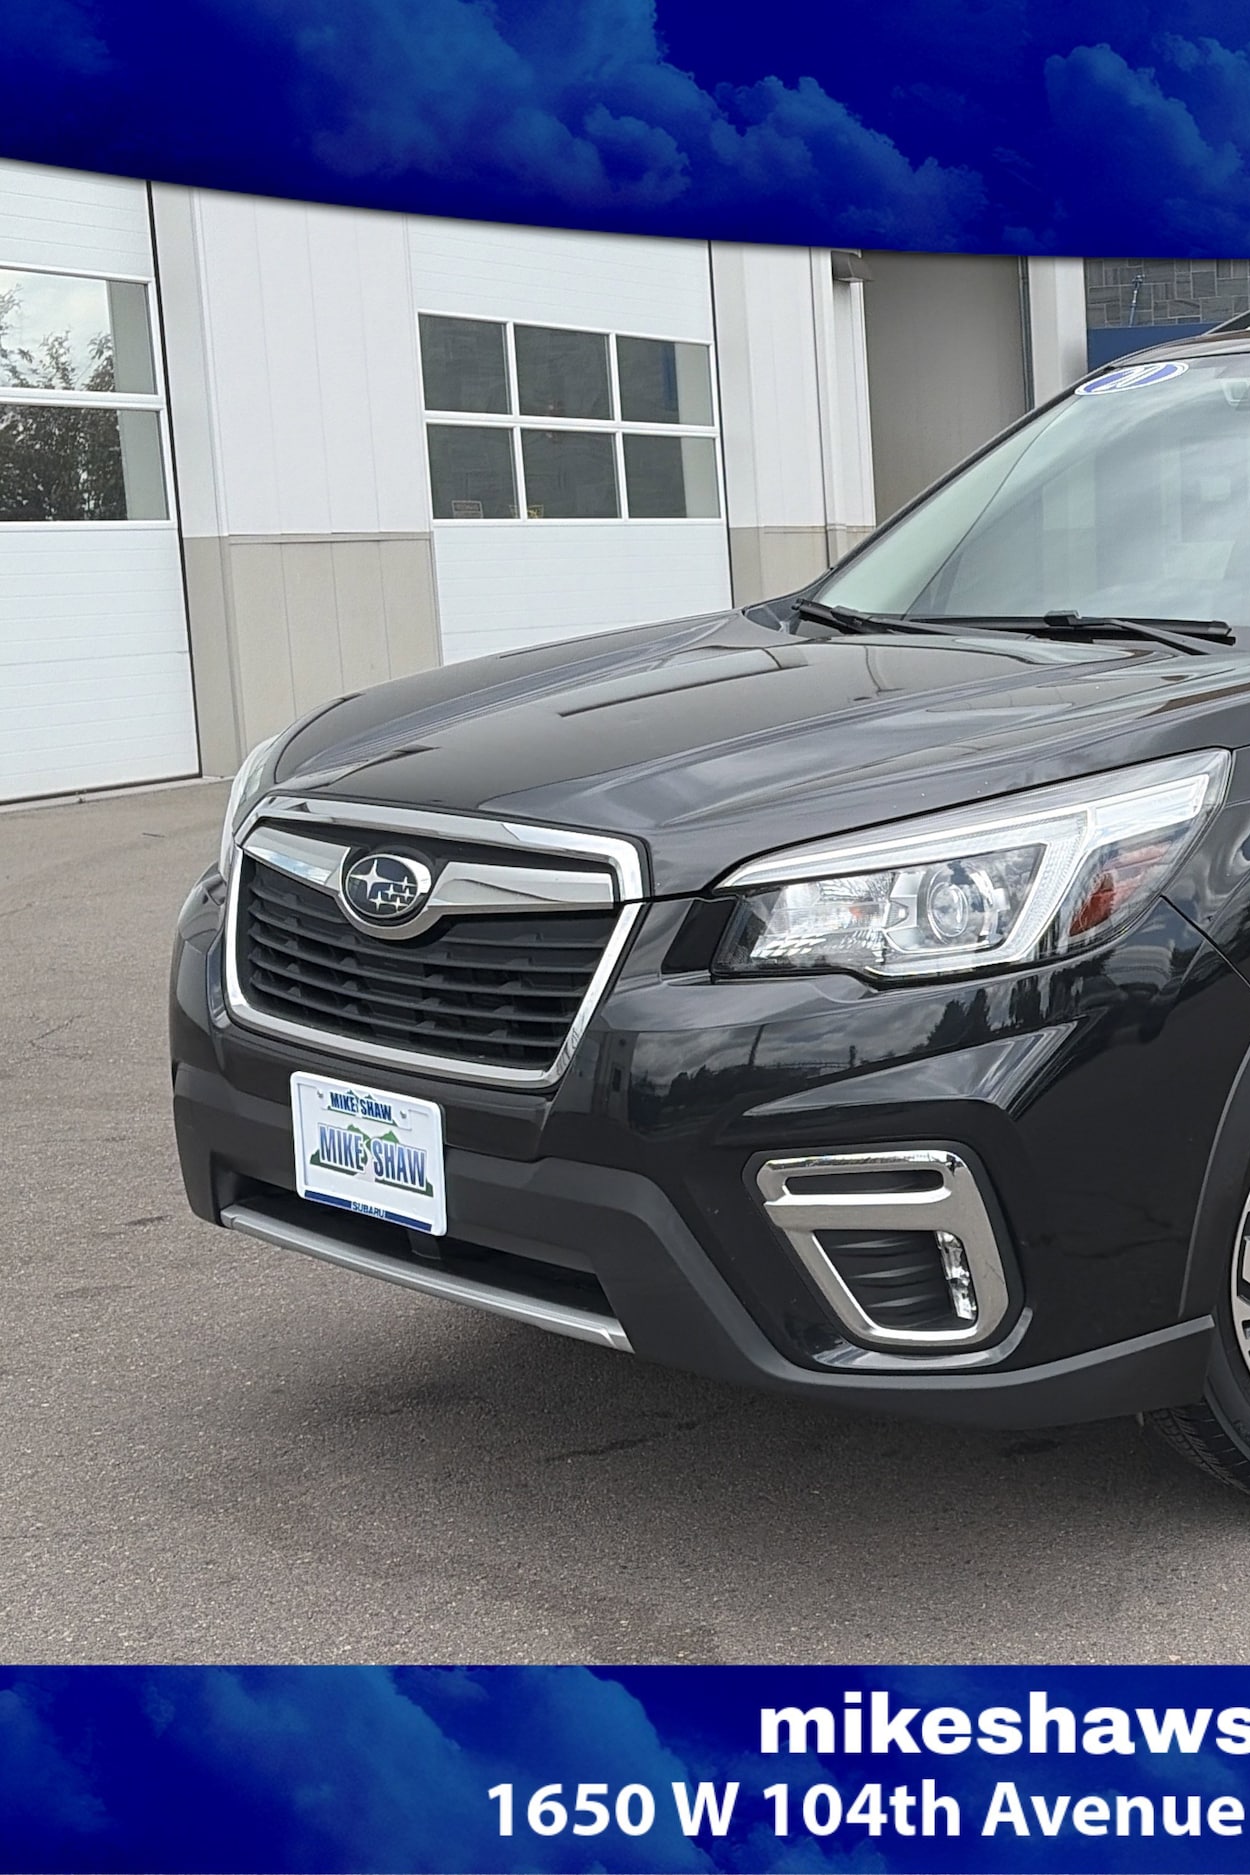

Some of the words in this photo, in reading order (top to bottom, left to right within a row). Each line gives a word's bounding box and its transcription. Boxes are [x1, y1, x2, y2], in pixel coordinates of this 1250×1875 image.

[330, 1091, 357, 1112] MIKE
[361, 1100, 392, 1121] SHAW
[319, 1125, 365, 1171] MIKE
[370, 1137, 426, 1188] SHAW
[352, 1201, 385, 1218] SUBARU
